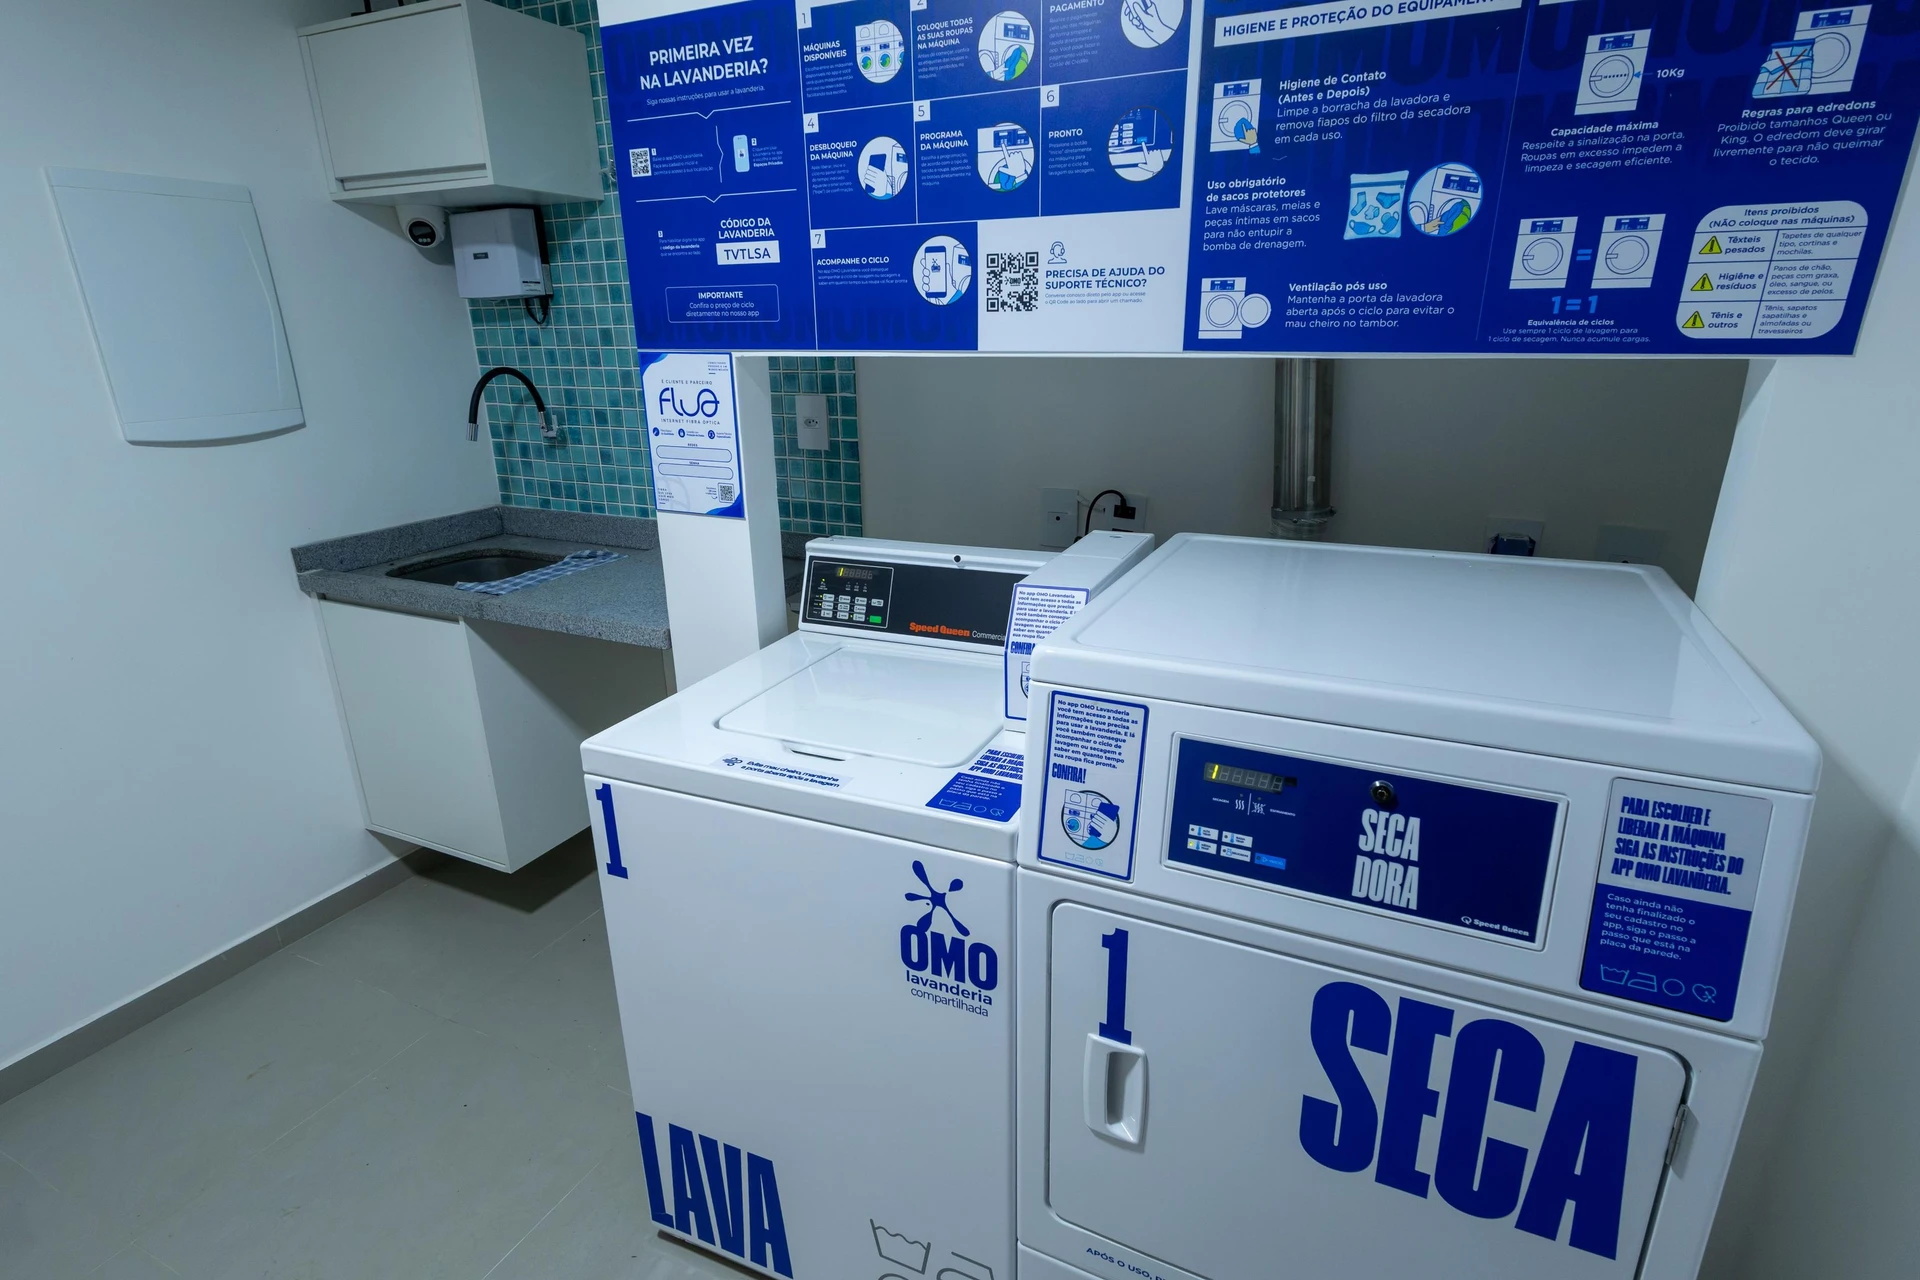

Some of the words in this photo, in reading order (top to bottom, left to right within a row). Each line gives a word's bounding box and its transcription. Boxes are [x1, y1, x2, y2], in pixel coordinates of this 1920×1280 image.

[917, 21, 948, 32] COLOQUE
[950, 17, 974, 27] TODAS
[1224, 20, 1276, 37] HIGIENE
[1280, 18, 1288, 30] E
[1292, 7, 1367, 28] PROTEÇÃO
[1372, 4, 1393, 17] DO
[927, 31, 944, 39] SUAS
[946, 26, 973, 37] ROUPAS
[804, 40, 840, 52] MÁQUINAS
[929, 38, 960, 48] MÁQUINA
[650, 42, 720, 65] PRIMEIRA
[723, 36, 754, 54] VEZ
[804, 50, 846, 62] DISPONÍVEIS
[640, 74, 661, 90] NA
[664, 58, 768, 86] LAVANDERIA?
[1657, 68, 1684, 78] 10Kg
[1280, 79, 1320, 90] Higiene
[1324, 76, 1337, 85] de
[1341, 71, 1386, 83] Contato
[735, 86, 765, 94] lavanderia.
[1047, 90, 1054, 102] 6
[1278, 93, 1313, 105] (Antes
[1327, 86, 1370, 99] Depois)
[918, 105, 925, 117] 5
[1277, 108, 1309, 117] Limpe
[1322, 101, 1370, 113] borracha
[1373, 99, 1387, 108] da
[1391, 95, 1439, 106] lavadora
[1742, 108, 1782, 118] Regras
[1786, 106, 1813, 116] para
[1817, 101, 1876, 112] edredons
[808, 118, 814, 128] 4
[1551, 124, 1613, 136] Capacidade
[1616, 121, 1658, 131] máxima
[921, 130, 962, 140] PROGRAMA
[1049, 128, 1082, 138] PRONTO
[810, 140, 857, 152] DESBLOQUEIO
[933, 140, 968, 149] MÁQUINA
[821, 151, 853, 159] MÁQUINA
[1208, 181, 1226, 189] Uso
[1229, 176, 1286, 188] obrigatório
[1206, 193, 1218, 202] de
[1222, 193, 1248, 201] sacos
[1252, 189, 1305, 201] protetores
[1771, 206, 1819, 216] proibidos
[721, 218, 755, 228] CÓDIGO
[758, 218, 771, 226] DA
[1709, 218, 1736, 228] (NÃO
[1801, 215, 1855, 224] máquinas)
[719, 228, 775, 239] LAVANDERIA
[815, 234, 821, 244] 7
[724, 248, 771, 260] TVTLSA
[1724, 246, 1765, 255] pesados
[1046, 269, 1088, 278] PRECISA
[1092, 268, 1106, 277] DE
[1109, 267, 1145, 276] AJUDA
[1149, 266, 1165, 275] DO
[1719, 272, 1755, 281] Higiêne
[1046, 280, 1092, 289] SUPORTE
[1095, 278, 1147, 288] TÉCNICO?
[1289, 282, 1342, 292] Ventilação
[1346, 282, 1365, 292] pós
[910, 622, 939, 634] Speed
[940, 625, 970, 636] Queen
[972, 630, 1005, 640] Commercia
[1096, 706, 1129, 716] Lavanderia
[1051, 762, 1087, 784] CONFIRA!
[1621, 796, 1649, 816] PARA
[1652, 801, 1703, 826] ESCOLHER
[1704, 809, 1711, 826] E
[595, 782, 628, 879] 1
[1359, 808, 1420, 861] SECA
[1618, 817, 1659, 840] LIBERAR
[1661, 824, 1669, 841] A
[1671, 825, 1726, 850] MÁQUINA
[1615, 838, 1640, 857] SIGA
[1641, 843, 1656, 860] AS
[1658, 845, 1726, 873] INSTRUÇÕES
[1727, 857, 1744, 875] DO
[1352, 855, 1419, 910] DORA
[1611, 858, 1634, 877] APP
[1635, 862, 1661, 882] OMO
[1662, 866, 1731, 895] LAVANDERIA.
[1608, 893, 1631, 903] Caso
[1633, 899, 1661, 909] ainda
[1474, 919, 1500, 930] Speed
[1502, 925, 1529, 936] Queen
[900, 924, 998, 990] OMO
[906, 970, 992, 1005] lavanderia
[1098, 928, 1132, 1045] 1
[911, 988, 988, 1017] compartilhada
[1300, 982, 1638, 1261] SECA
[635, 1111, 793, 1279] LAVA
[1086, 1248, 1114, 1264] APÓS
